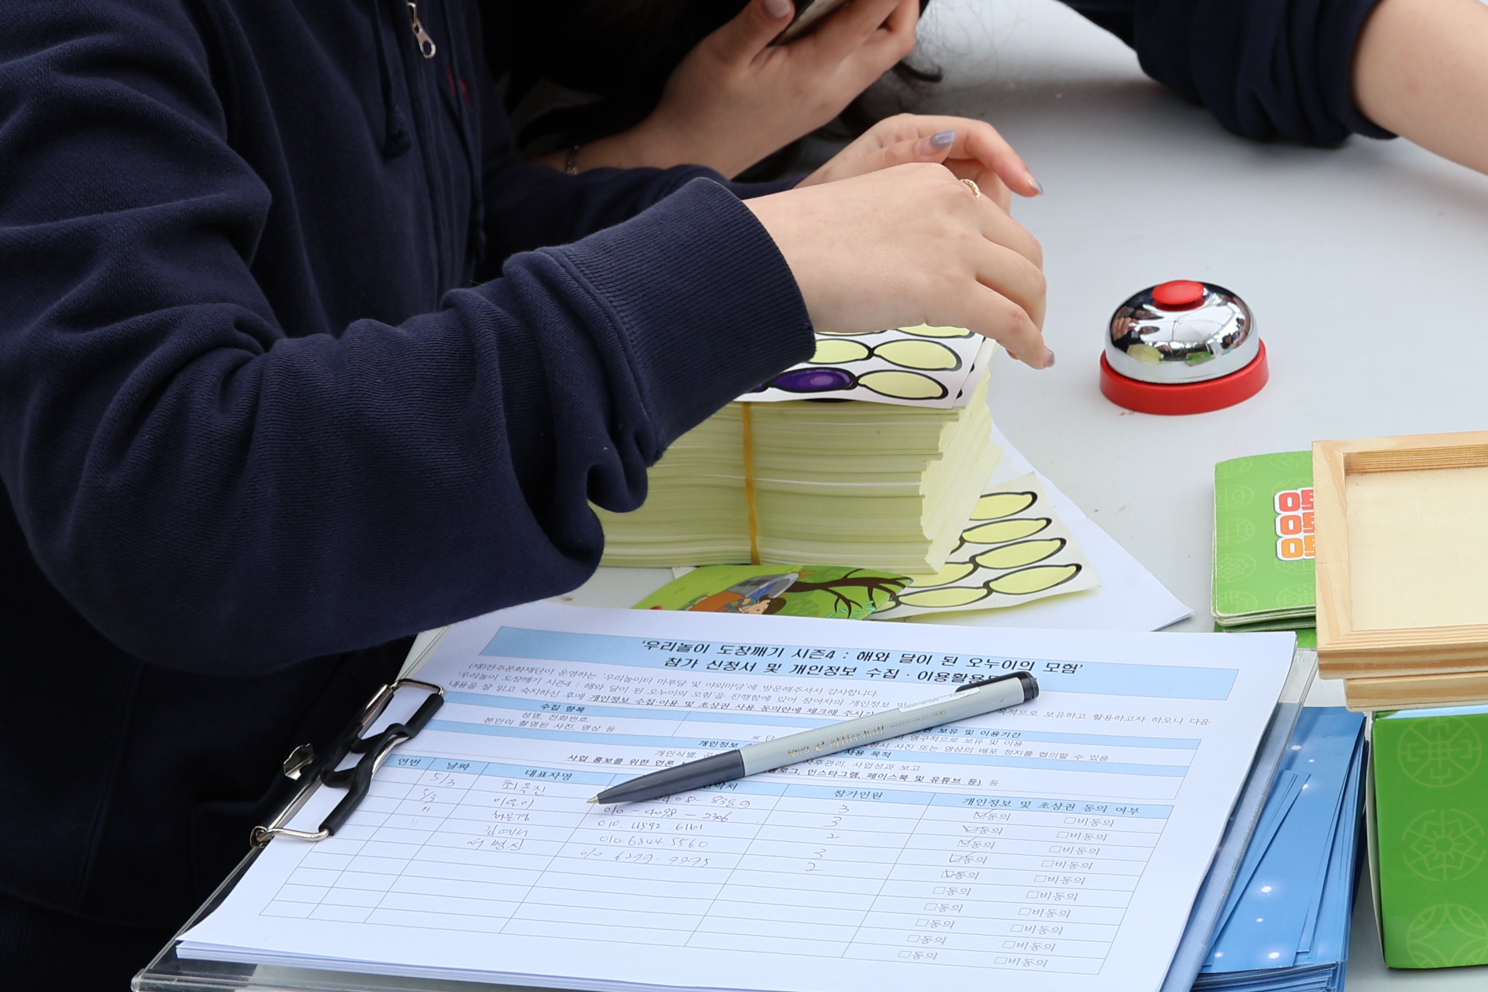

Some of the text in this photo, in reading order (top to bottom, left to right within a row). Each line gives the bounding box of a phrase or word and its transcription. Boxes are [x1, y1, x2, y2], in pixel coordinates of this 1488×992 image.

[717, 644, 785, 658] 도장깨기
[791, 648, 836, 660] 시즌4
[857, 650, 890, 663] 해와
[899, 653, 933, 665] 달이
[941, 656, 958, 667] 된
[966, 657, 1036, 671] 오누이의
[664, 657, 698, 668] 참가
[706, 660, 757, 672] 신청서
[763, 663, 781, 673] 및
[789, 664, 857, 678] 개인정보
[865, 667, 900, 679] 수집
[469, 662, 554, 676] (재)전주문화재단이
[559, 669, 597, 679] 운영하는
[691, 680, 701, 688] 및
[763, 684, 824, 695] 방문해주셔서
[829, 688, 878, 697] 감사합니다.
[501, 675, 542, 685] 도장깨기
[546, 679, 572, 688] 시즌4
[584, 682, 605, 691] 해와
[609, 685, 629, 694] 달이
[633, 687, 644, 695] 된
[647, 687, 688, 697] 오누이의
[730, 693, 771, 702] 진행함에
[776, 695, 797, 704] 있어
[802, 697, 844, 707] 참여자의
[849, 699, 890, 708] 개인정보
[448, 681, 478, 690] 내용을
[497, 684, 517, 693] 읽고
[520, 687, 560, 698] 숙지하신
[563, 692, 585, 700] 후에
[588, 693, 629, 704] 개인정보
[701, 701, 730, 710] 초상권
[734, 703, 755, 711] 사용
[807, 708, 839, 717] 체크해
[540, 703, 585, 713] 수집 항목
[1043, 709, 1087, 719] 보유하고
[1092, 713, 1147, 723] 활용하고자
[1151, 717, 1185, 725] 하오니
[1189, 718, 1211, 726] 다음
[483, 716, 514, 725] 본인이
[518, 719, 549, 728] 촬영된
[580, 724, 600, 732] 영상
[605, 725, 615, 733] 등
[939, 727, 958, 735] 보유
[964, 728, 975, 736] 및
[979, 730, 1022, 738] 이용기간
[698, 740, 738, 749] 개인정보
[962, 738, 985, 746] 보유
[988, 739, 1000, 747] 및
[871, 750, 892, 758] 목적
[895, 743, 914, 751] 사진
[919, 744, 940, 752] 또는
[978, 748, 998, 756] 배포
[1038, 751, 1068, 760] 협의할
[1089, 754, 1109, 762] 있음
[567, 754, 676, 767] 사업 홍보를 위한 언론
[852, 761, 895, 770] 사업성과
[446, 762, 470, 771] 날짜
[525, 770, 573, 781] 대표자명
[807, 769, 860, 779] 인스타그램,
[866, 772, 909, 782] 페이스북
[914, 775, 925, 783] 및
[930, 776, 961, 784] 유튜브
[967, 778, 981, 786] 등)
[989, 779, 999, 787] 등
[834, 789, 883, 799] 참가인원
[962, 797, 1140, 815] 개인정보 및 초상권 동의 여부
[823, 816, 842, 828] 3
[1078, 817, 1114, 827] 비동의
[1071, 832, 1107, 842] 비동의
[1063, 846, 1100, 856] 비동의
[805, 861, 823, 872] 2
[1056, 861, 1093, 871] 비동의
[1048, 876, 1086, 886] 비동의
[946, 887, 971, 897] 동의
[1041, 891, 1078, 901] 비동의
[939, 903, 963, 913] 동의
[1033, 908, 1071, 918] 비동의
[930, 919, 954, 929] 동의
[1026, 925, 1063, 935] 비동의
[922, 936, 946, 945] 동의
[1018, 942, 1055, 952] 비동의
[913, 951, 938, 961] 동의
[1010, 957, 1048, 967] 비동의
